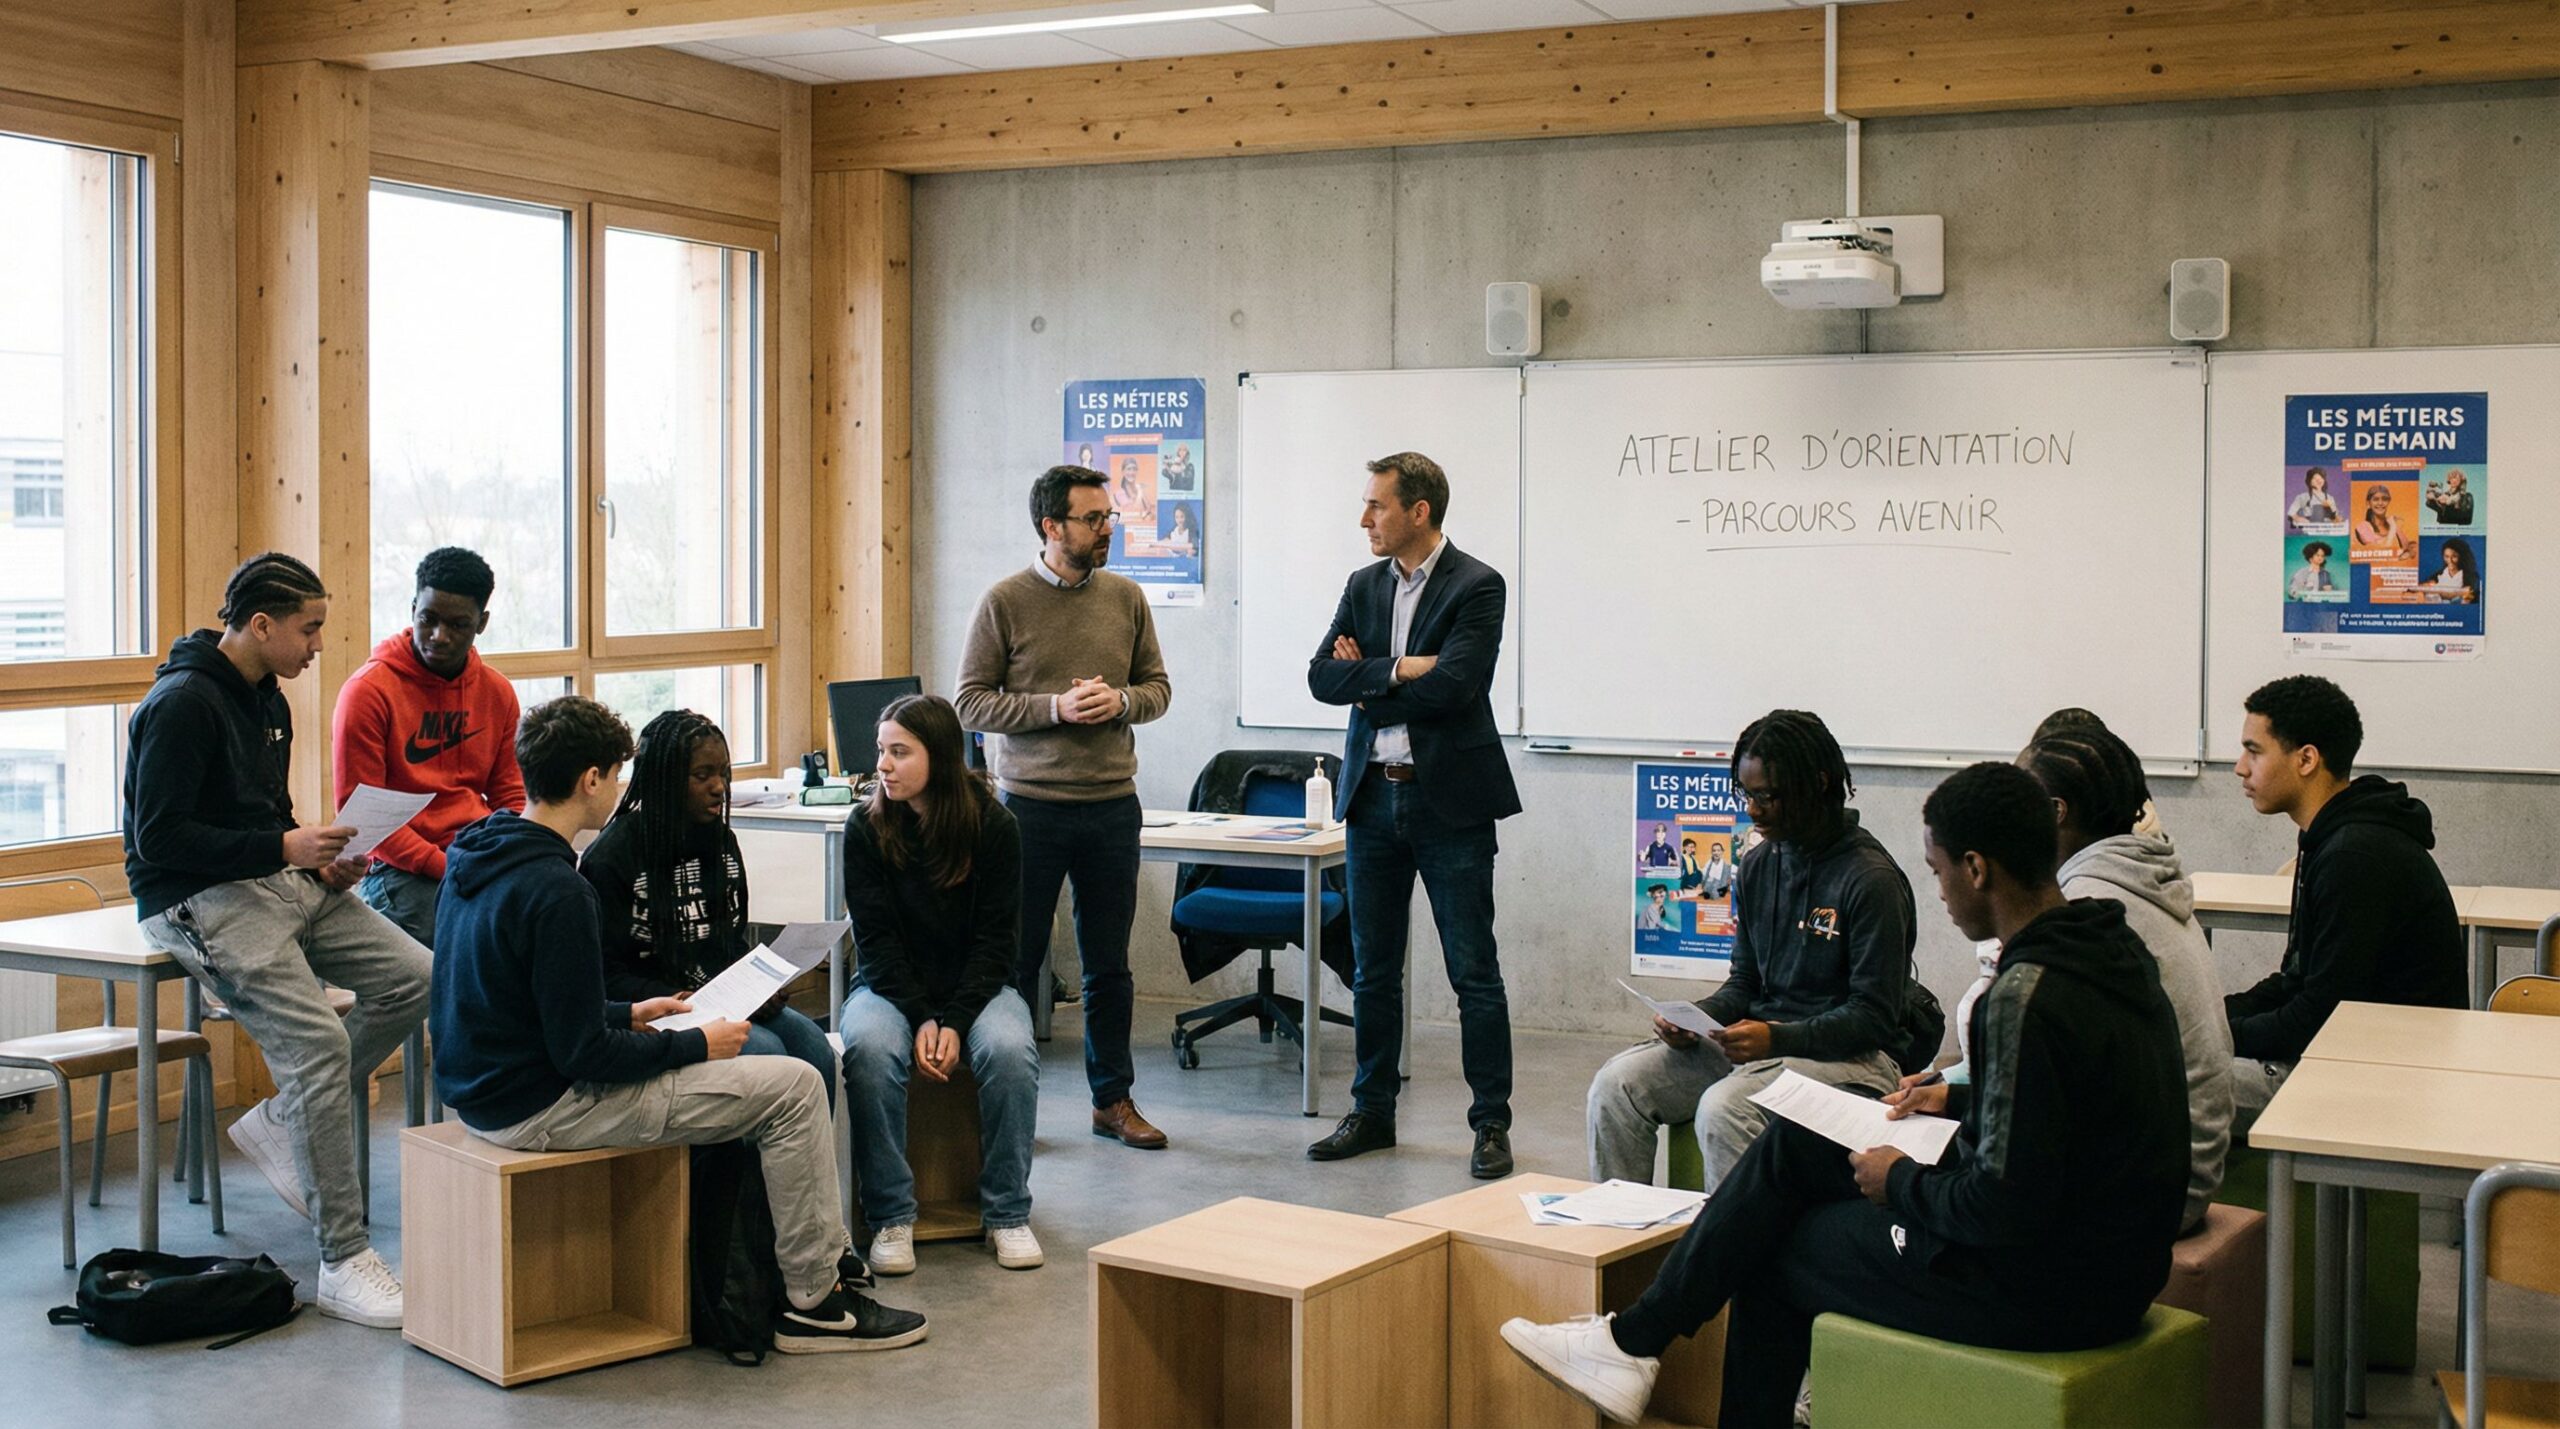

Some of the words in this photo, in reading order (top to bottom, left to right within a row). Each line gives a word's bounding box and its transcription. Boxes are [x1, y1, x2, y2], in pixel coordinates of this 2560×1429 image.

[1078, 392, 1109, 410] LES
[1113, 388, 1189, 409] MÉTIERS
[1083, 412, 1107, 429] DE
[1110, 411, 1183, 429] DEMAIN
[2307, 408, 2349, 428] LES
[2356, 403, 2465, 427] MÉTIERS
[2314, 432, 2347, 451] DE
[2354, 430, 2456, 451] DEMAIN
[1702, 498, 1858, 535] PARCOURS
[417, 711, 470, 742] NIKE
[1650, 775, 1680, 791] LES
[1685, 773, 1735, 793] MÉTI
[1656, 793, 1679, 809] DE
[1684, 794, 1748, 813] DEMAI
